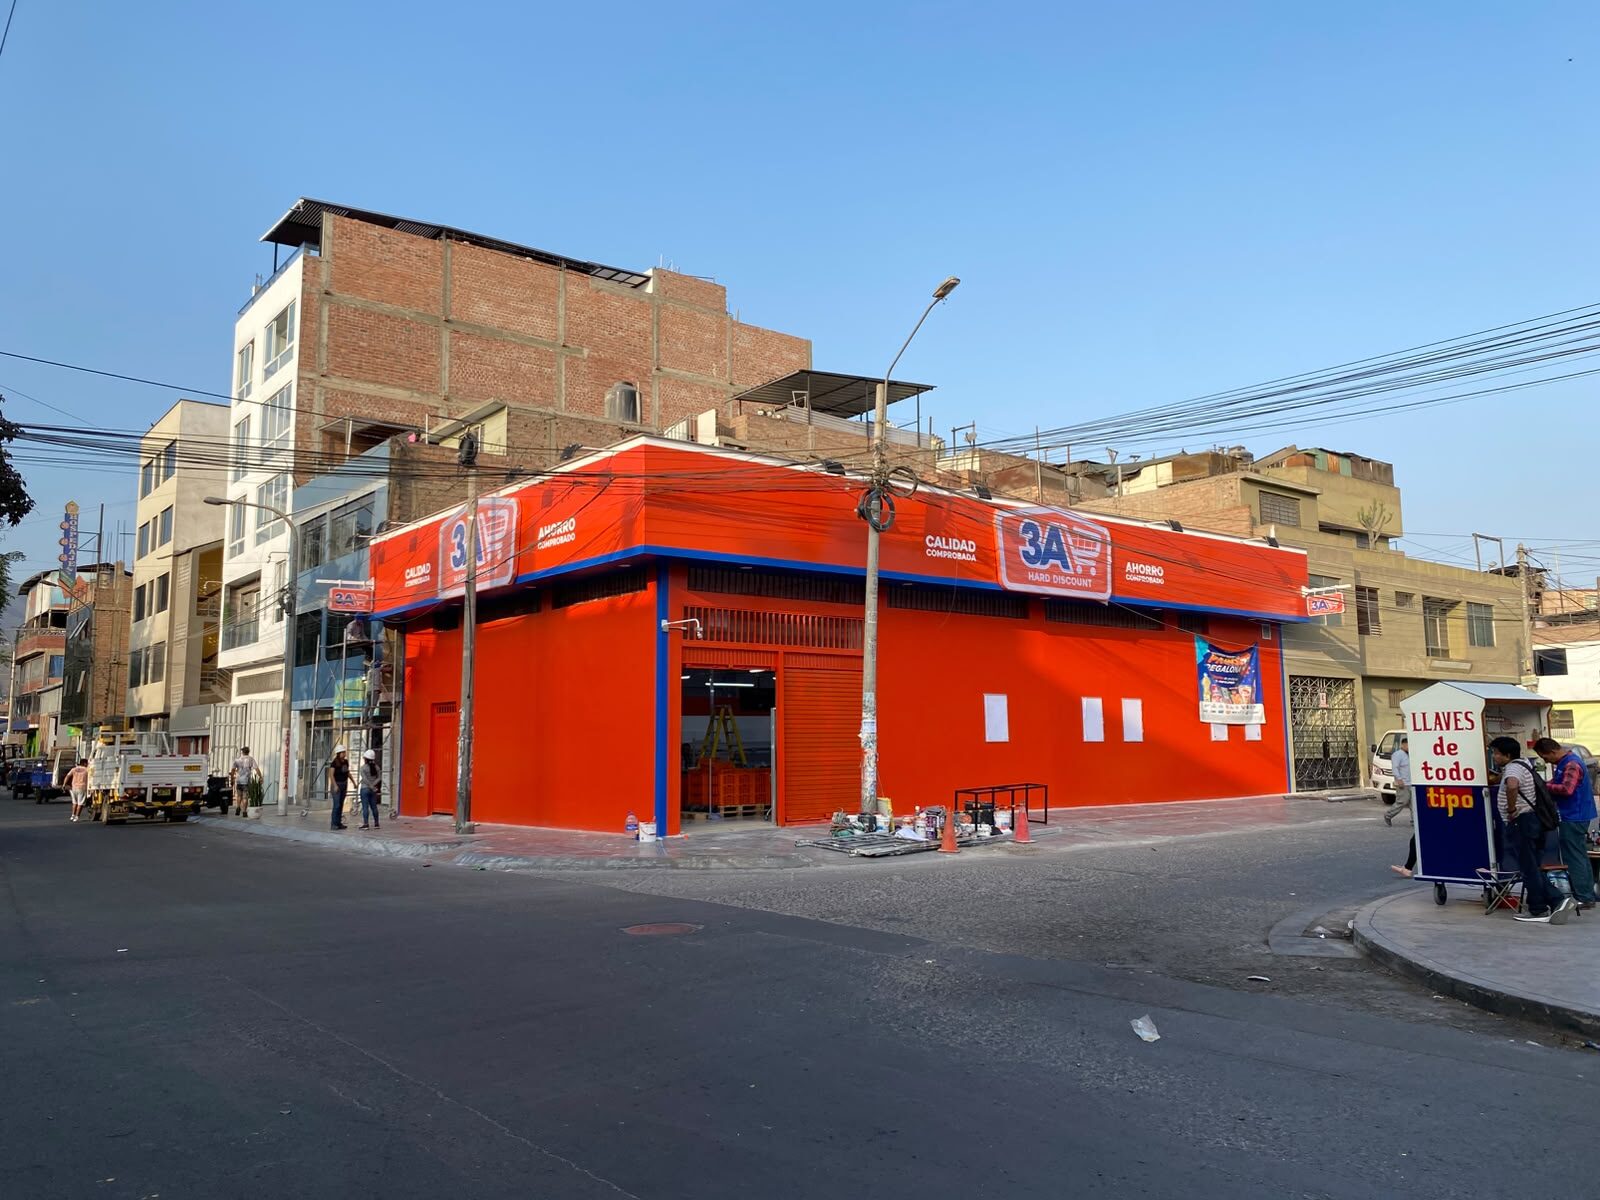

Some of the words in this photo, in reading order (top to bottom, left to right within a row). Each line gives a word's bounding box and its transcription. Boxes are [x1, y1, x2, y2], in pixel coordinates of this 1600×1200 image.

[538, 518, 576, 540] AHORRO
[68, 514, 78, 566] HOSPEDAJE
[537, 533, 576, 549] COMPROBADO
[925, 535, 976, 553] CALIDAD
[1018, 519, 1073, 573] 3A
[925, 549, 977, 562] COMPROBADA
[1125, 561, 1164, 577] AHORRO
[1028, 571, 1051, 583] HARD
[1052, 575, 1092, 588] DISCOUNT
[1125, 573, 1165, 585] COMPROBADO
[335, 592, 354, 605] 3A
[1311, 600, 1328, 611] 3A
[1411, 711, 1475, 732] LLAVES
[1432, 736, 1459, 756] de
[1422, 761, 1475, 782] todo
[1427, 787, 1474, 817] tipo
